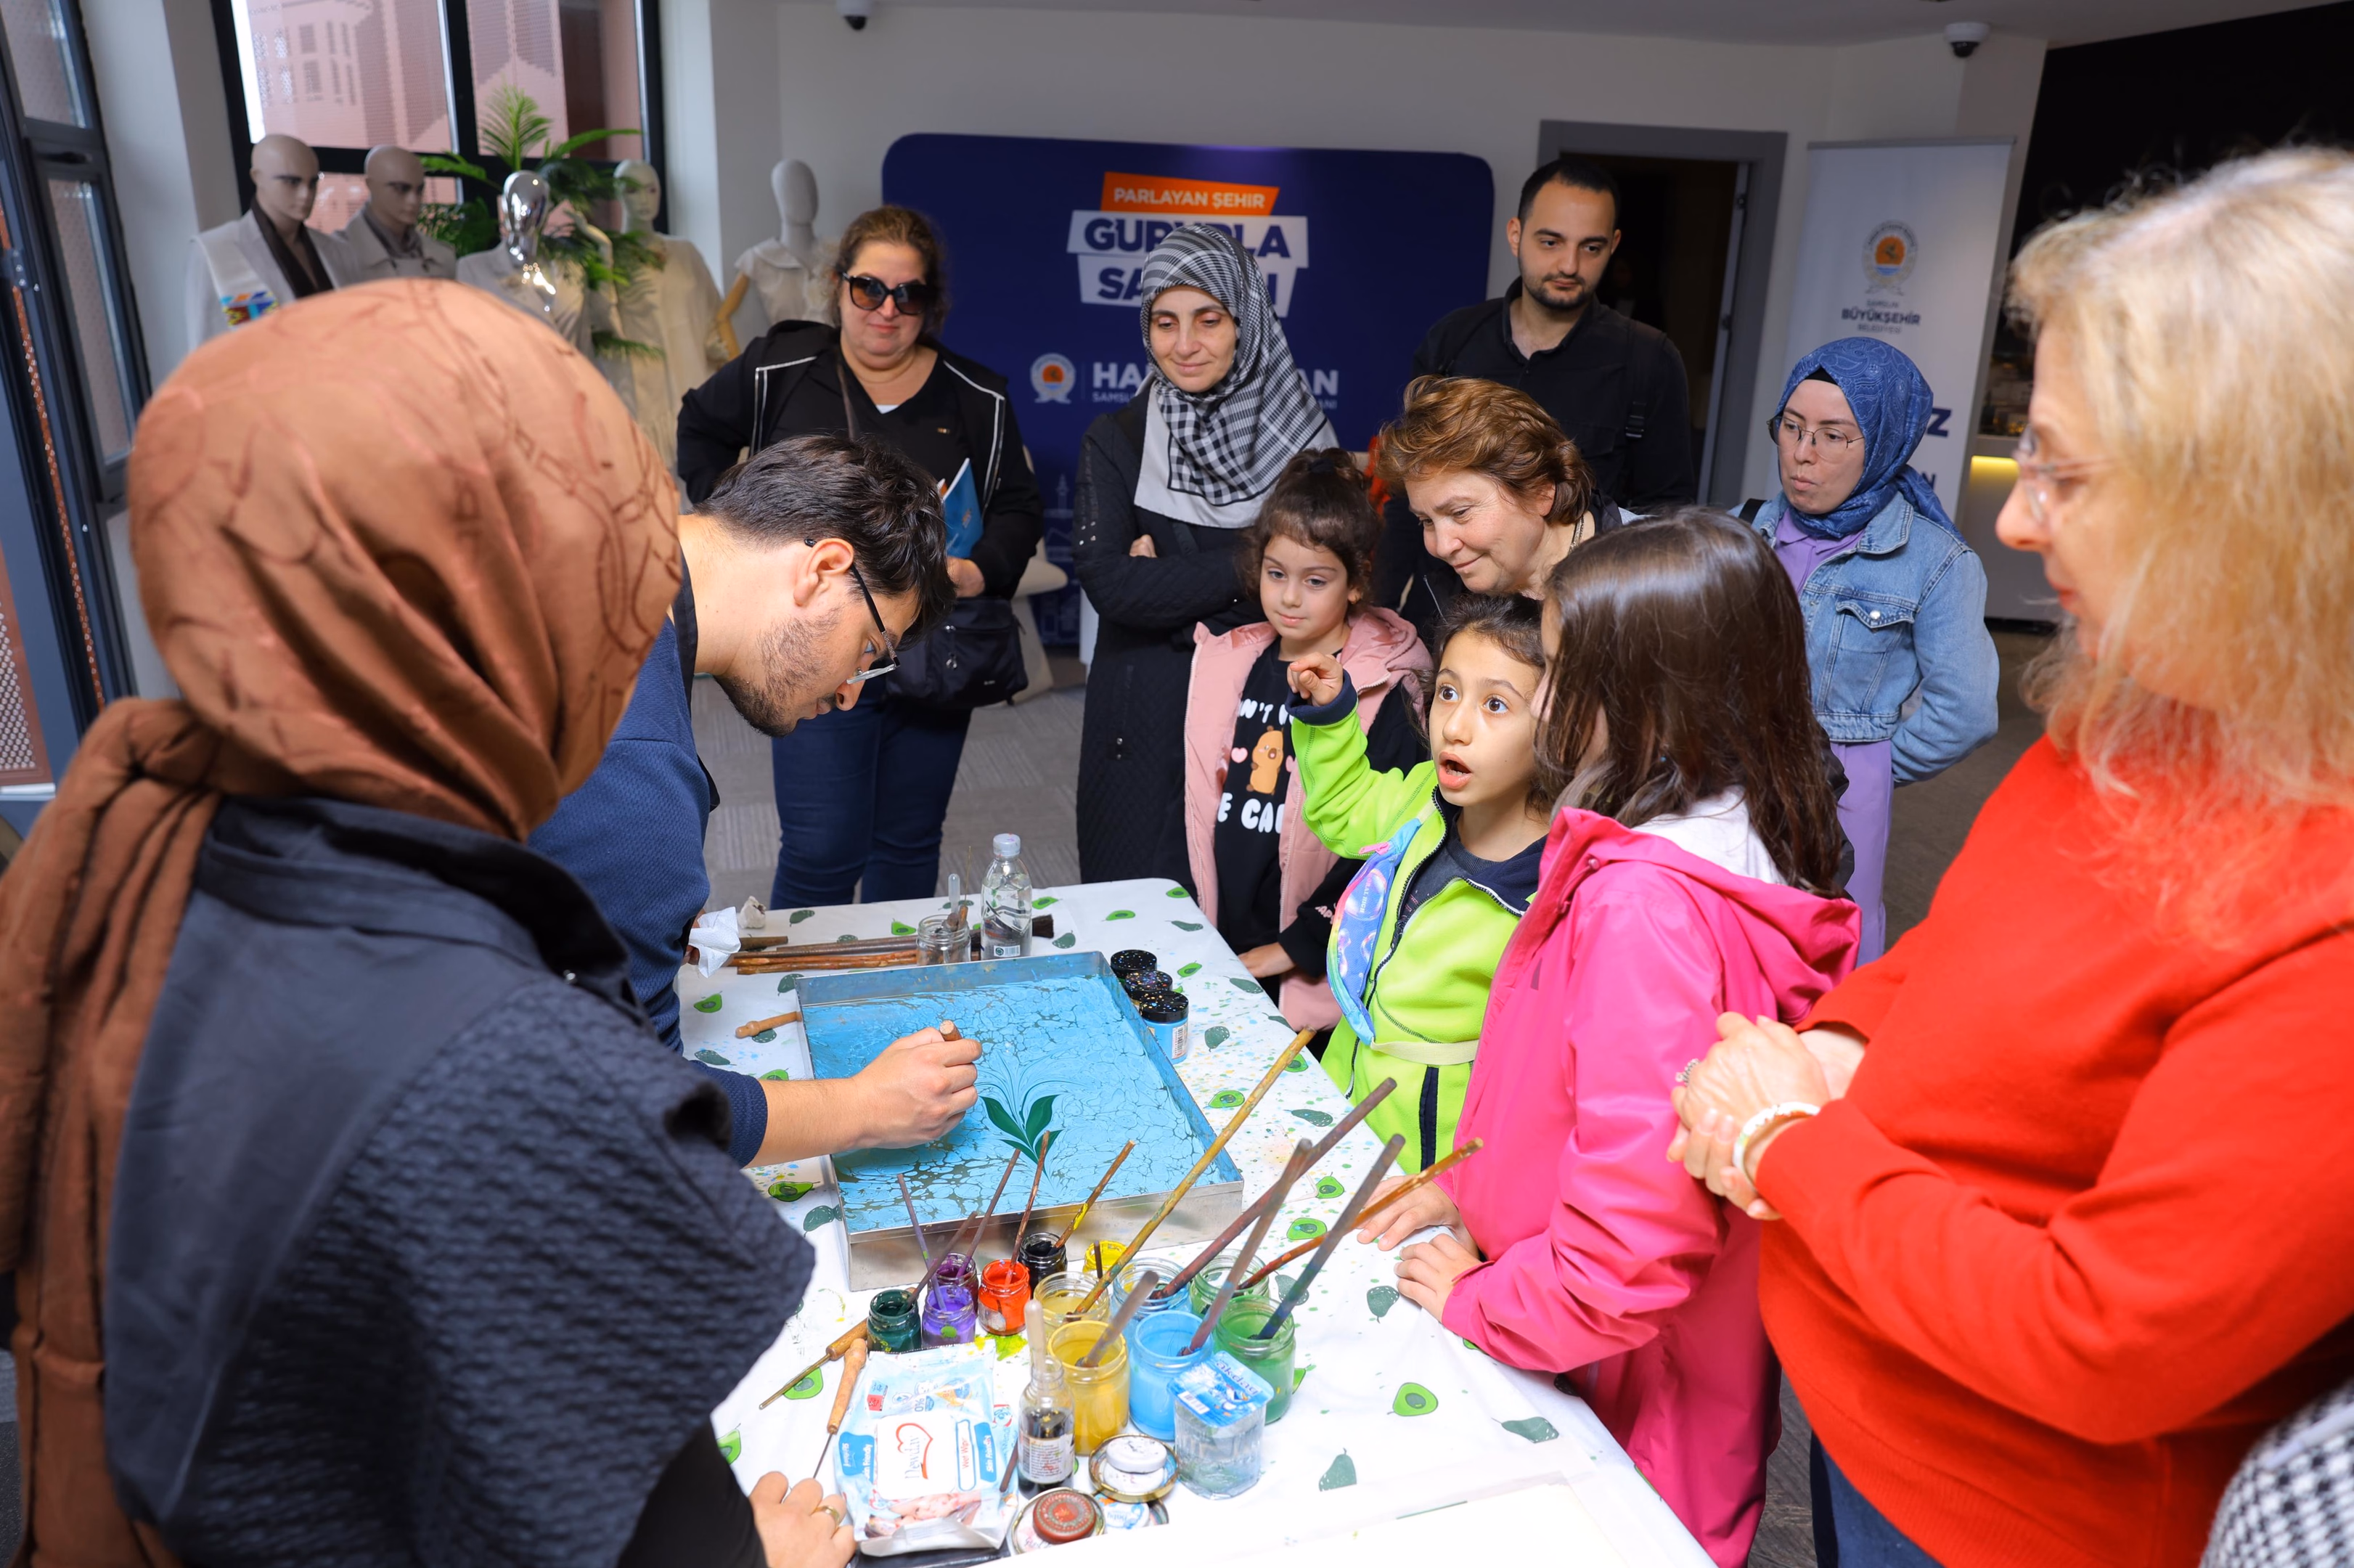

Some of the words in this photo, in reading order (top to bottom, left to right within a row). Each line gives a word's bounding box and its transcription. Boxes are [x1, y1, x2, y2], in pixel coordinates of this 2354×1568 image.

[1113, 187, 1208, 208] PARLAYAN
[1212, 192, 1266, 209] ŞEHİR
[1842, 306, 1921, 325] BÜYÜKŞEHİR
